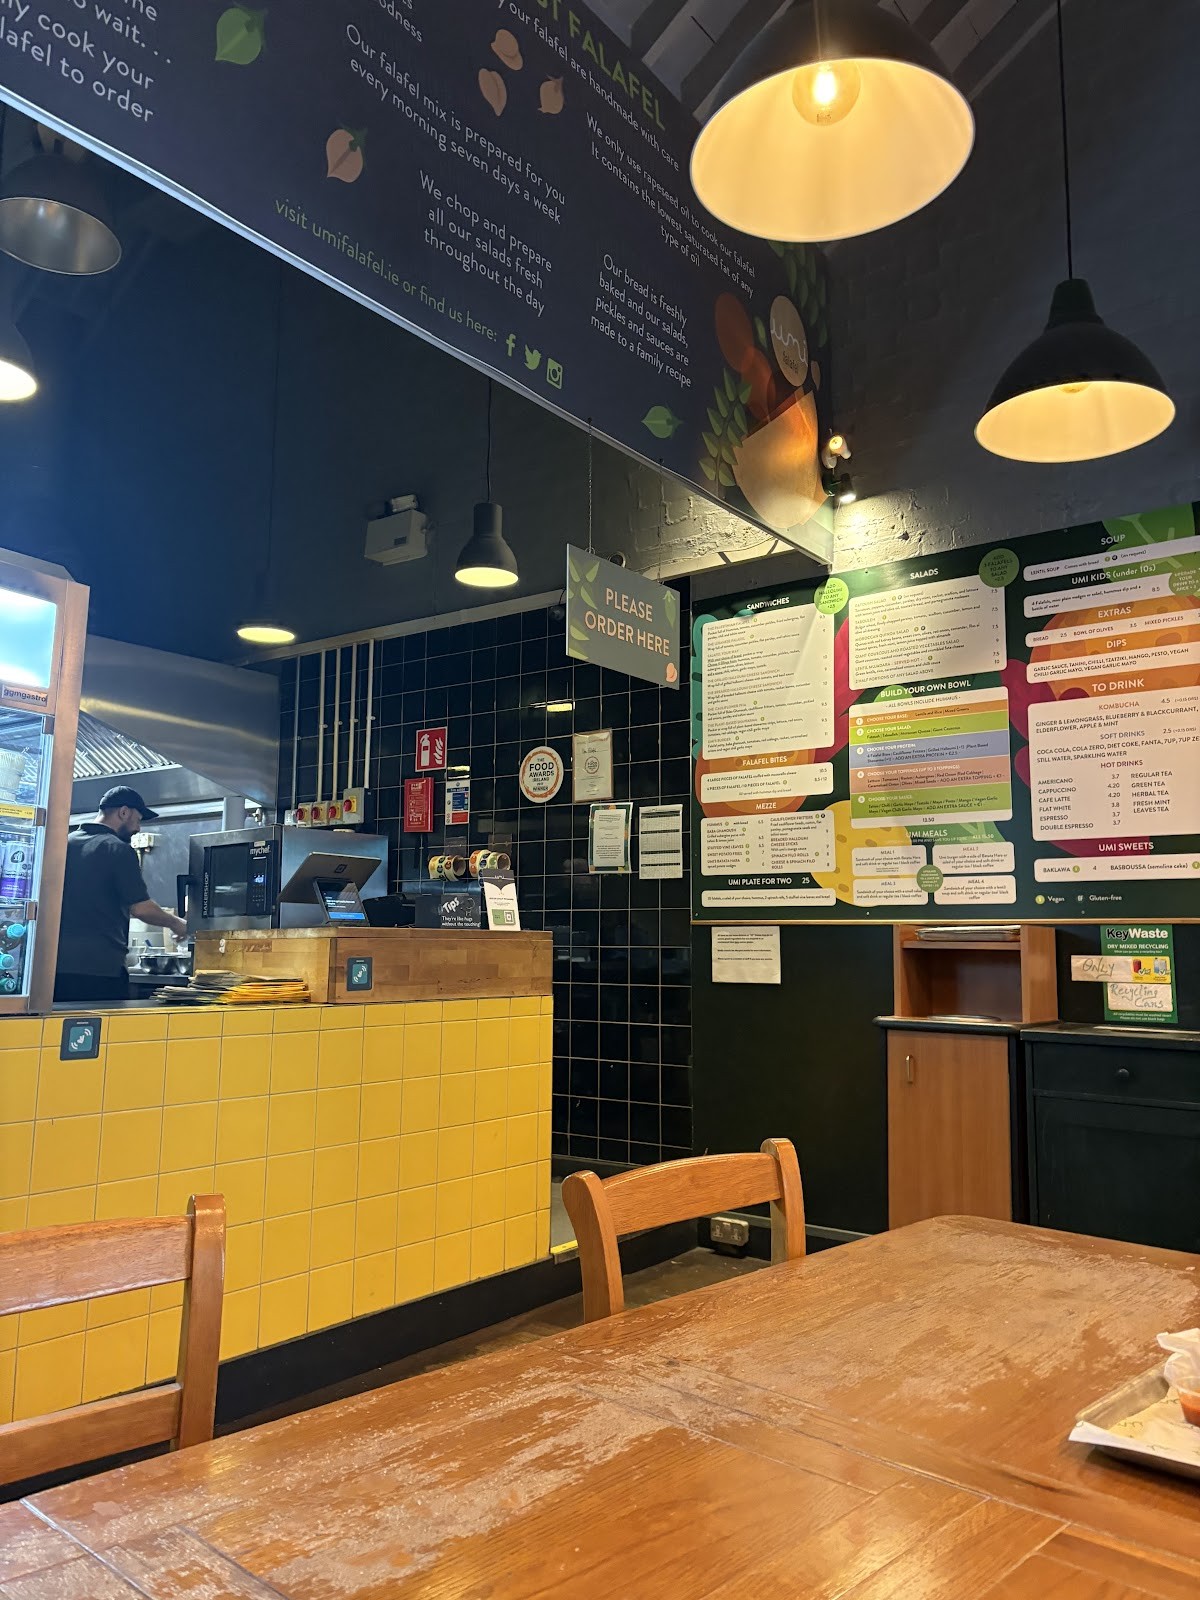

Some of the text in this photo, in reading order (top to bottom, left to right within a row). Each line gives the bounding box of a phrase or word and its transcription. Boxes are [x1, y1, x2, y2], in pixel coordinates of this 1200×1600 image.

[38, 14, 154, 89] cook your
[0, 16, 154, 122] lafel to order
[568, 10, 666, 131] FALAFEL
[509, 2, 531, 25] our
[533, 17, 568, 61] falafel
[570, 58, 587, 80] are
[589, 71, 639, 131] handmade
[641, 127, 660, 152] with
[661, 151, 680, 171] care
[346, 24, 565, 206] Our falafel mix is prepared for you
[350, 58, 561, 225] every morning seven days a week
[586, 111, 755, 278] We only use rapeseed oil to cook our falafel
[419, 169, 552, 272] We chop and prepare
[591, 141, 754, 299] It contains the lowest saturated fat of any
[428, 207, 544, 289] all our salads fresh
[661, 224, 700, 267] type of oil
[275, 199, 497, 342] visit umifalafel.ie or find us here:
[424, 228, 545, 318] throughout the day
[603, 254, 688, 328] Our bread is freshly
[599, 272, 688, 349] baked and our salads,
[595, 296, 689, 366] pickles and sauces are
[590, 315, 691, 388] made to a family recipe
[1100, 534, 1126, 545] SOUP
[909, 568, 939, 580] SALADS
[1071, 564, 1156, 585] UMI KIDS (under 10s)
[606, 587, 653, 623] PLEASE
[746, 597, 790, 611] SANDWICHES
[1098, 606, 1132, 618] EXTRAS
[585, 610, 634, 644] ORDER
[637, 628, 670, 657] HERE
[1106, 639, 1127, 649] DIPS
[880, 679, 971, 698] BUILD YOUR OWN BOWL
[1092, 678, 1145, 692] TO DRINK
[1098, 701, 1140, 711] KOMBUCHA
[1100, 732, 1118, 740] SOFT
[529, 762, 554, 771] FOOD
[742, 756, 787, 766] FALAFEL BITES
[1100, 761, 1115, 769] HOT
[529, 770, 554, 778] AWARDS
[1038, 777, 1074, 786] AMERICANO
[1131, 771, 1160, 779] REGULAR
[1038, 787, 1077, 795] CAPPUCCINO
[1131, 781, 1152, 789] GREEN
[756, 802, 777, 810] MEZZE
[906, 829, 948, 839] UMI MEALS
[1098, 842, 1154, 851] UMI SWEETS
[728, 878, 740, 886] UMI
[442, 897, 460, 913] Tips
[1048, 894, 1122, 903] Vegan Gluten-free
[1106, 928, 1168, 941] KeyWaste
[1110, 983, 1158, 1001] Recycling
